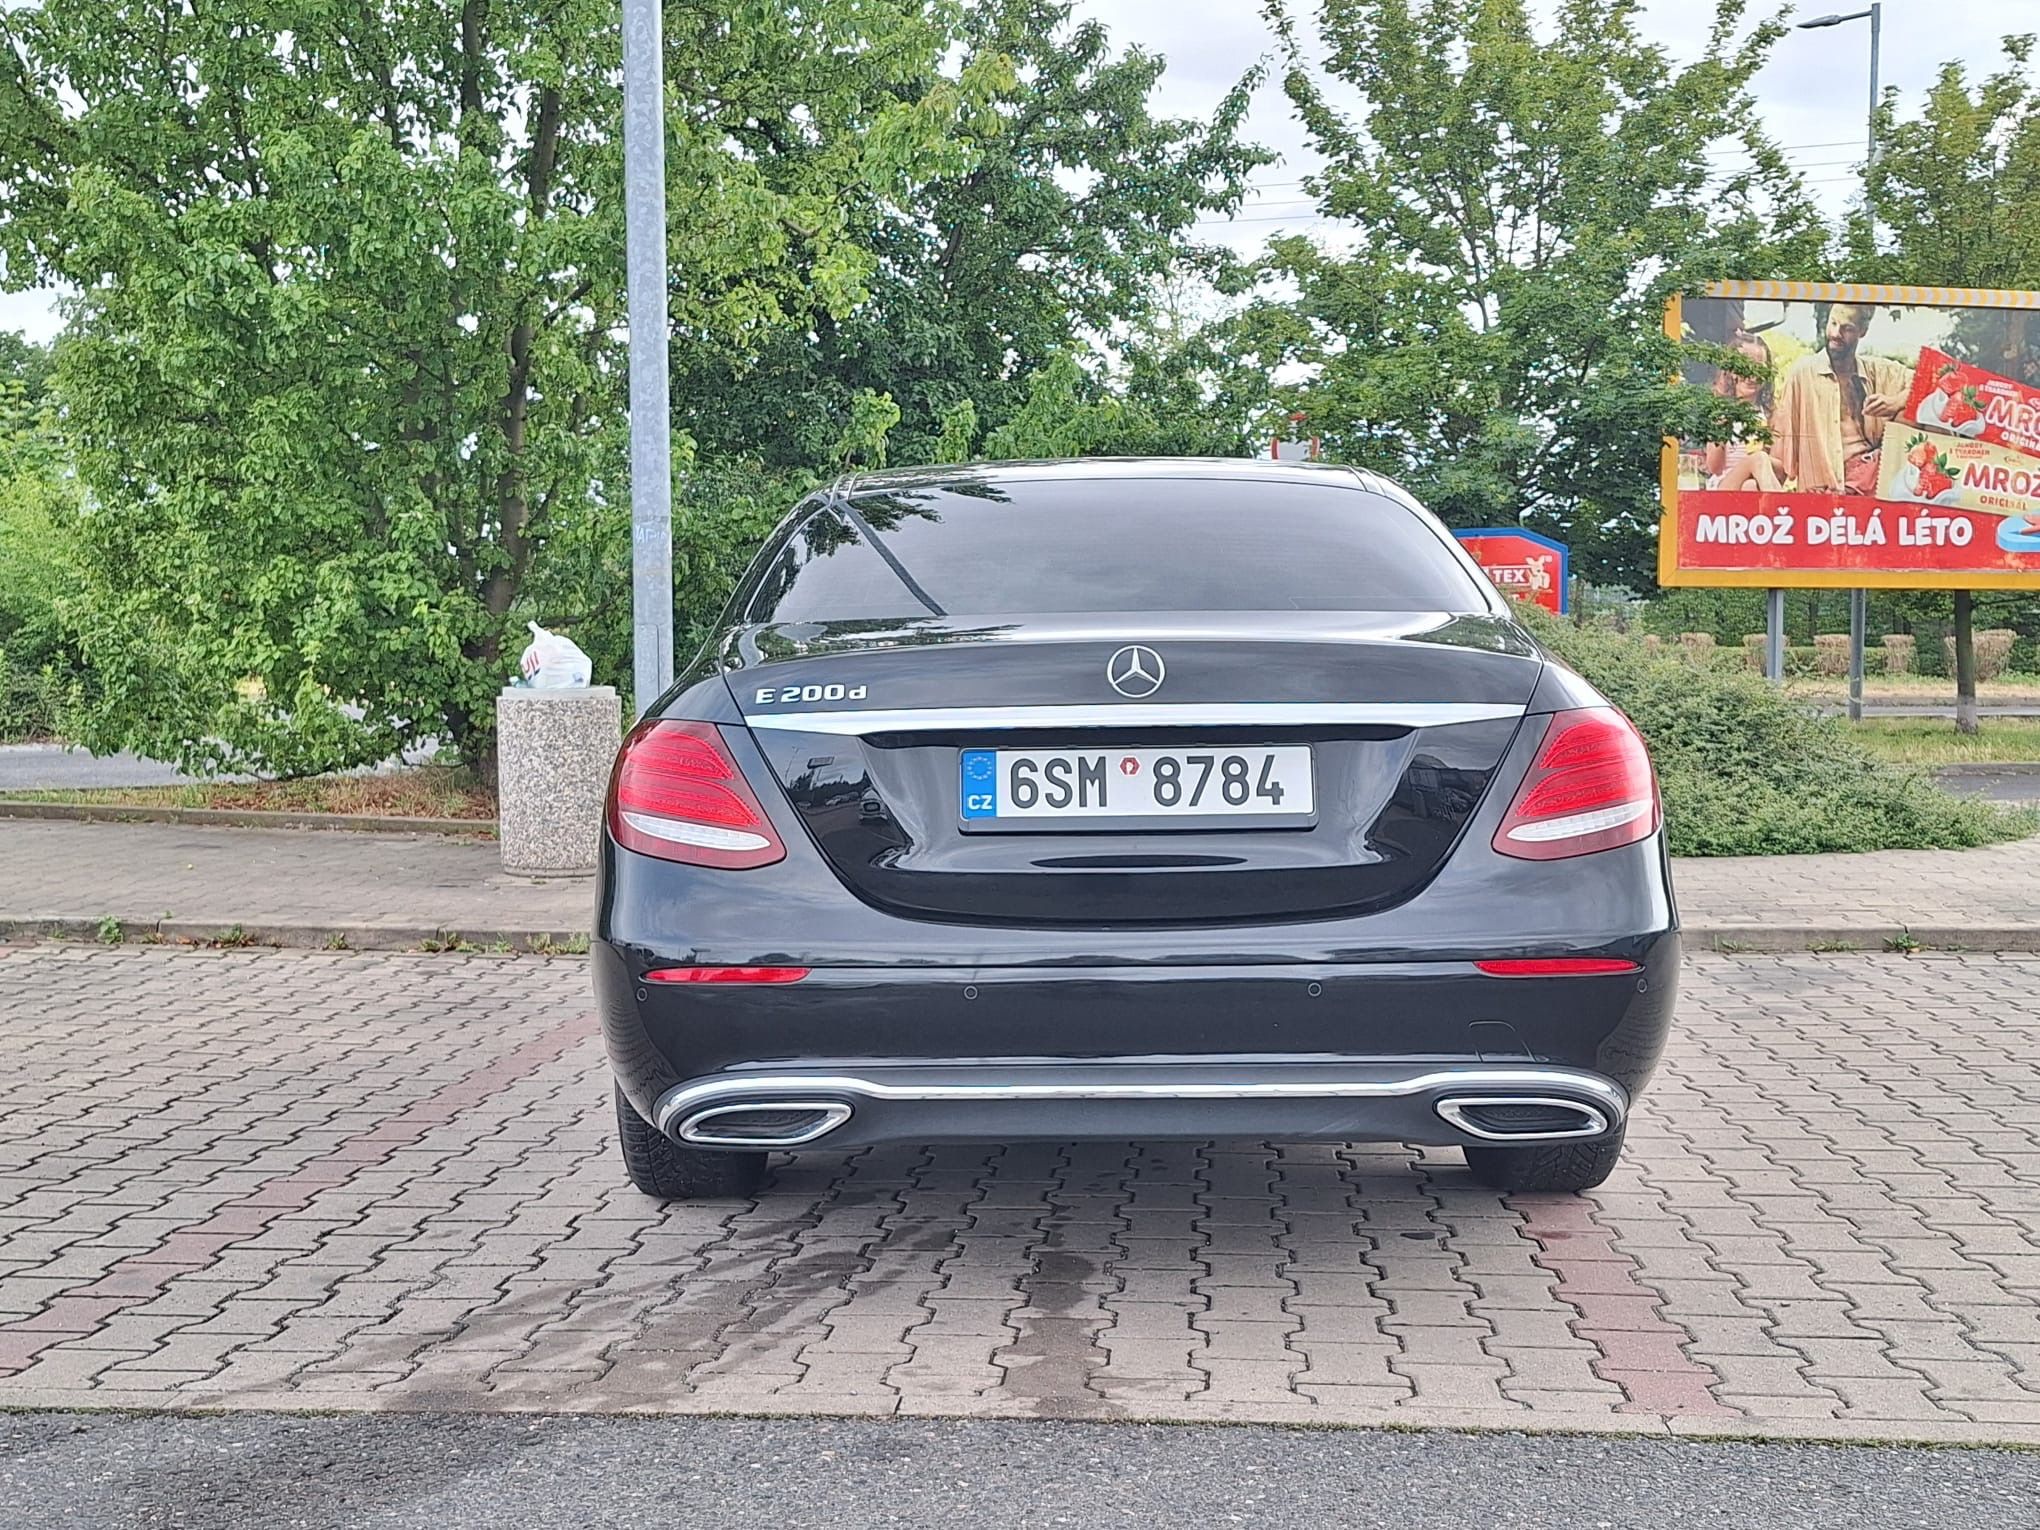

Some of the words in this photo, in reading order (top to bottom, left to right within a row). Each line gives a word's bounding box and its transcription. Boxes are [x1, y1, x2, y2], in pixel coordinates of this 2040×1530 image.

[1696, 506, 1795, 545] MROŽ
[1807, 506, 1886, 546] DĚLÁ
[1898, 508, 1973, 547] LÉTO
[755, 688, 777, 704] E
[1010, 756, 1107, 809] 6SM
[1153, 755, 1285, 807] 8784
[968, 795, 993, 810] CZ
